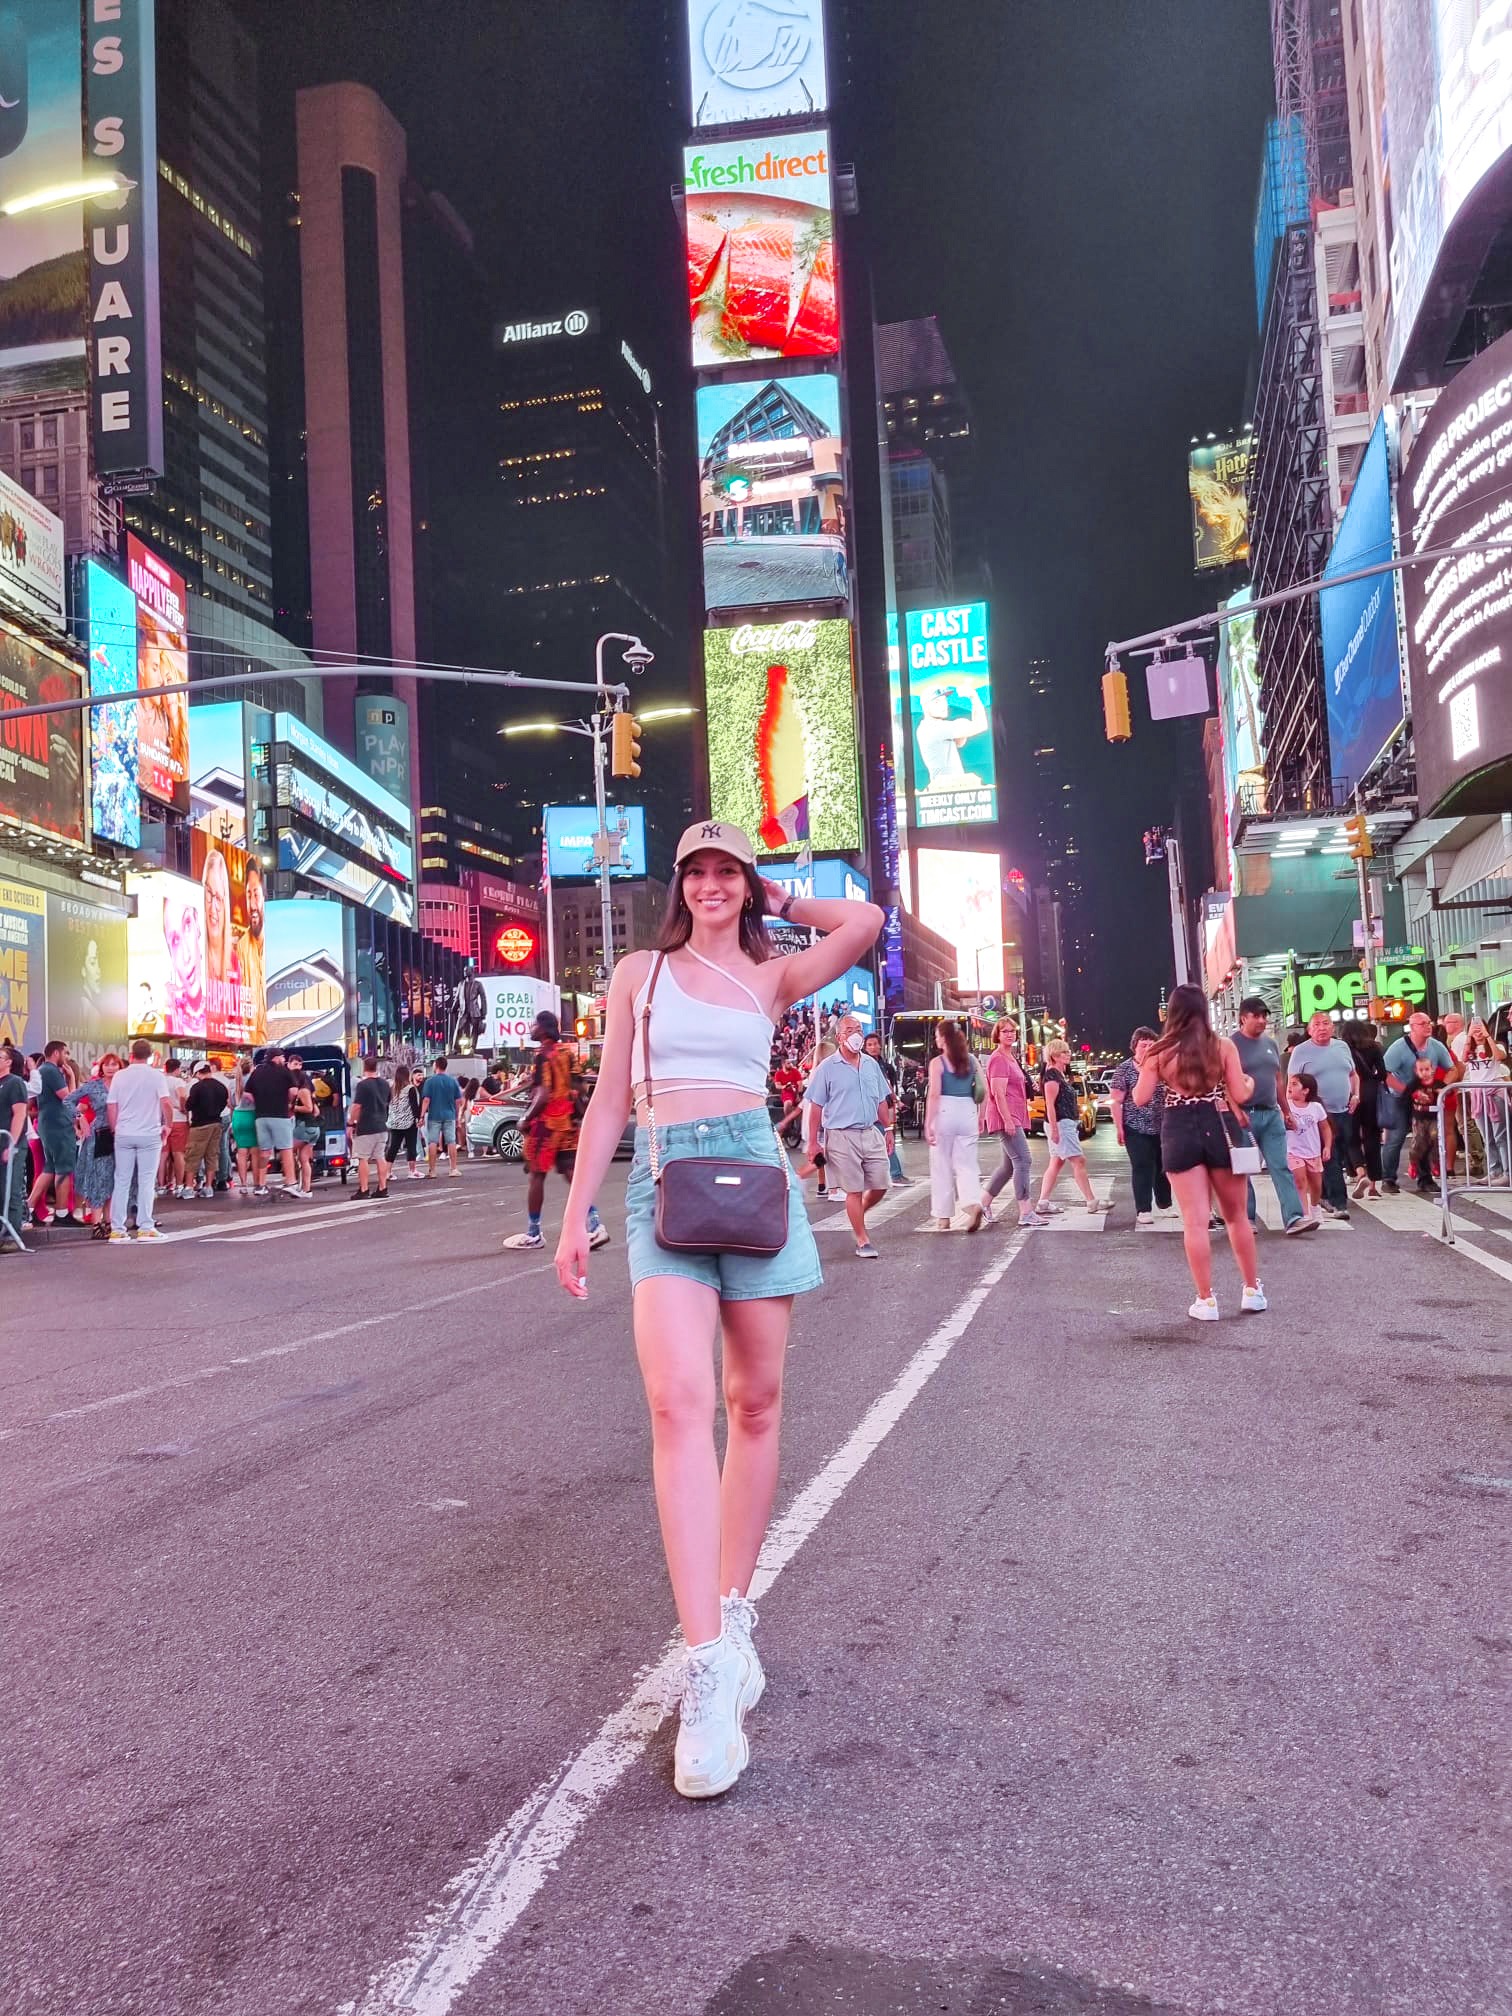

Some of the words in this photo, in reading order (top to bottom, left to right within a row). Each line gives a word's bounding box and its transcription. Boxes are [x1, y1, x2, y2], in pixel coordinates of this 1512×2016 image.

[690, 150, 829, 188] freshdirect
[502, 320, 564, 344] Allianz
[1447, 371, 1512, 449] PROJEC
[131, 558, 166, 615] HAPPILY
[920, 607, 972, 639] CAST
[730, 619, 817, 655] Coca-Cola
[911, 636, 986, 670] CASTLE
[153, 770, 173, 792] TLC
[978, 789, 992, 803] ON
[701, 823, 721, 839] NY
[206, 977, 240, 1017] HAPPILY
[275, 979, 309, 990] critical
[496, 992, 529, 1004] GRAB
[499, 1020, 531, 1036] NO
[66, 1039, 129, 1066] HICAGO
[1470, 1060, 1492, 1071] NY
